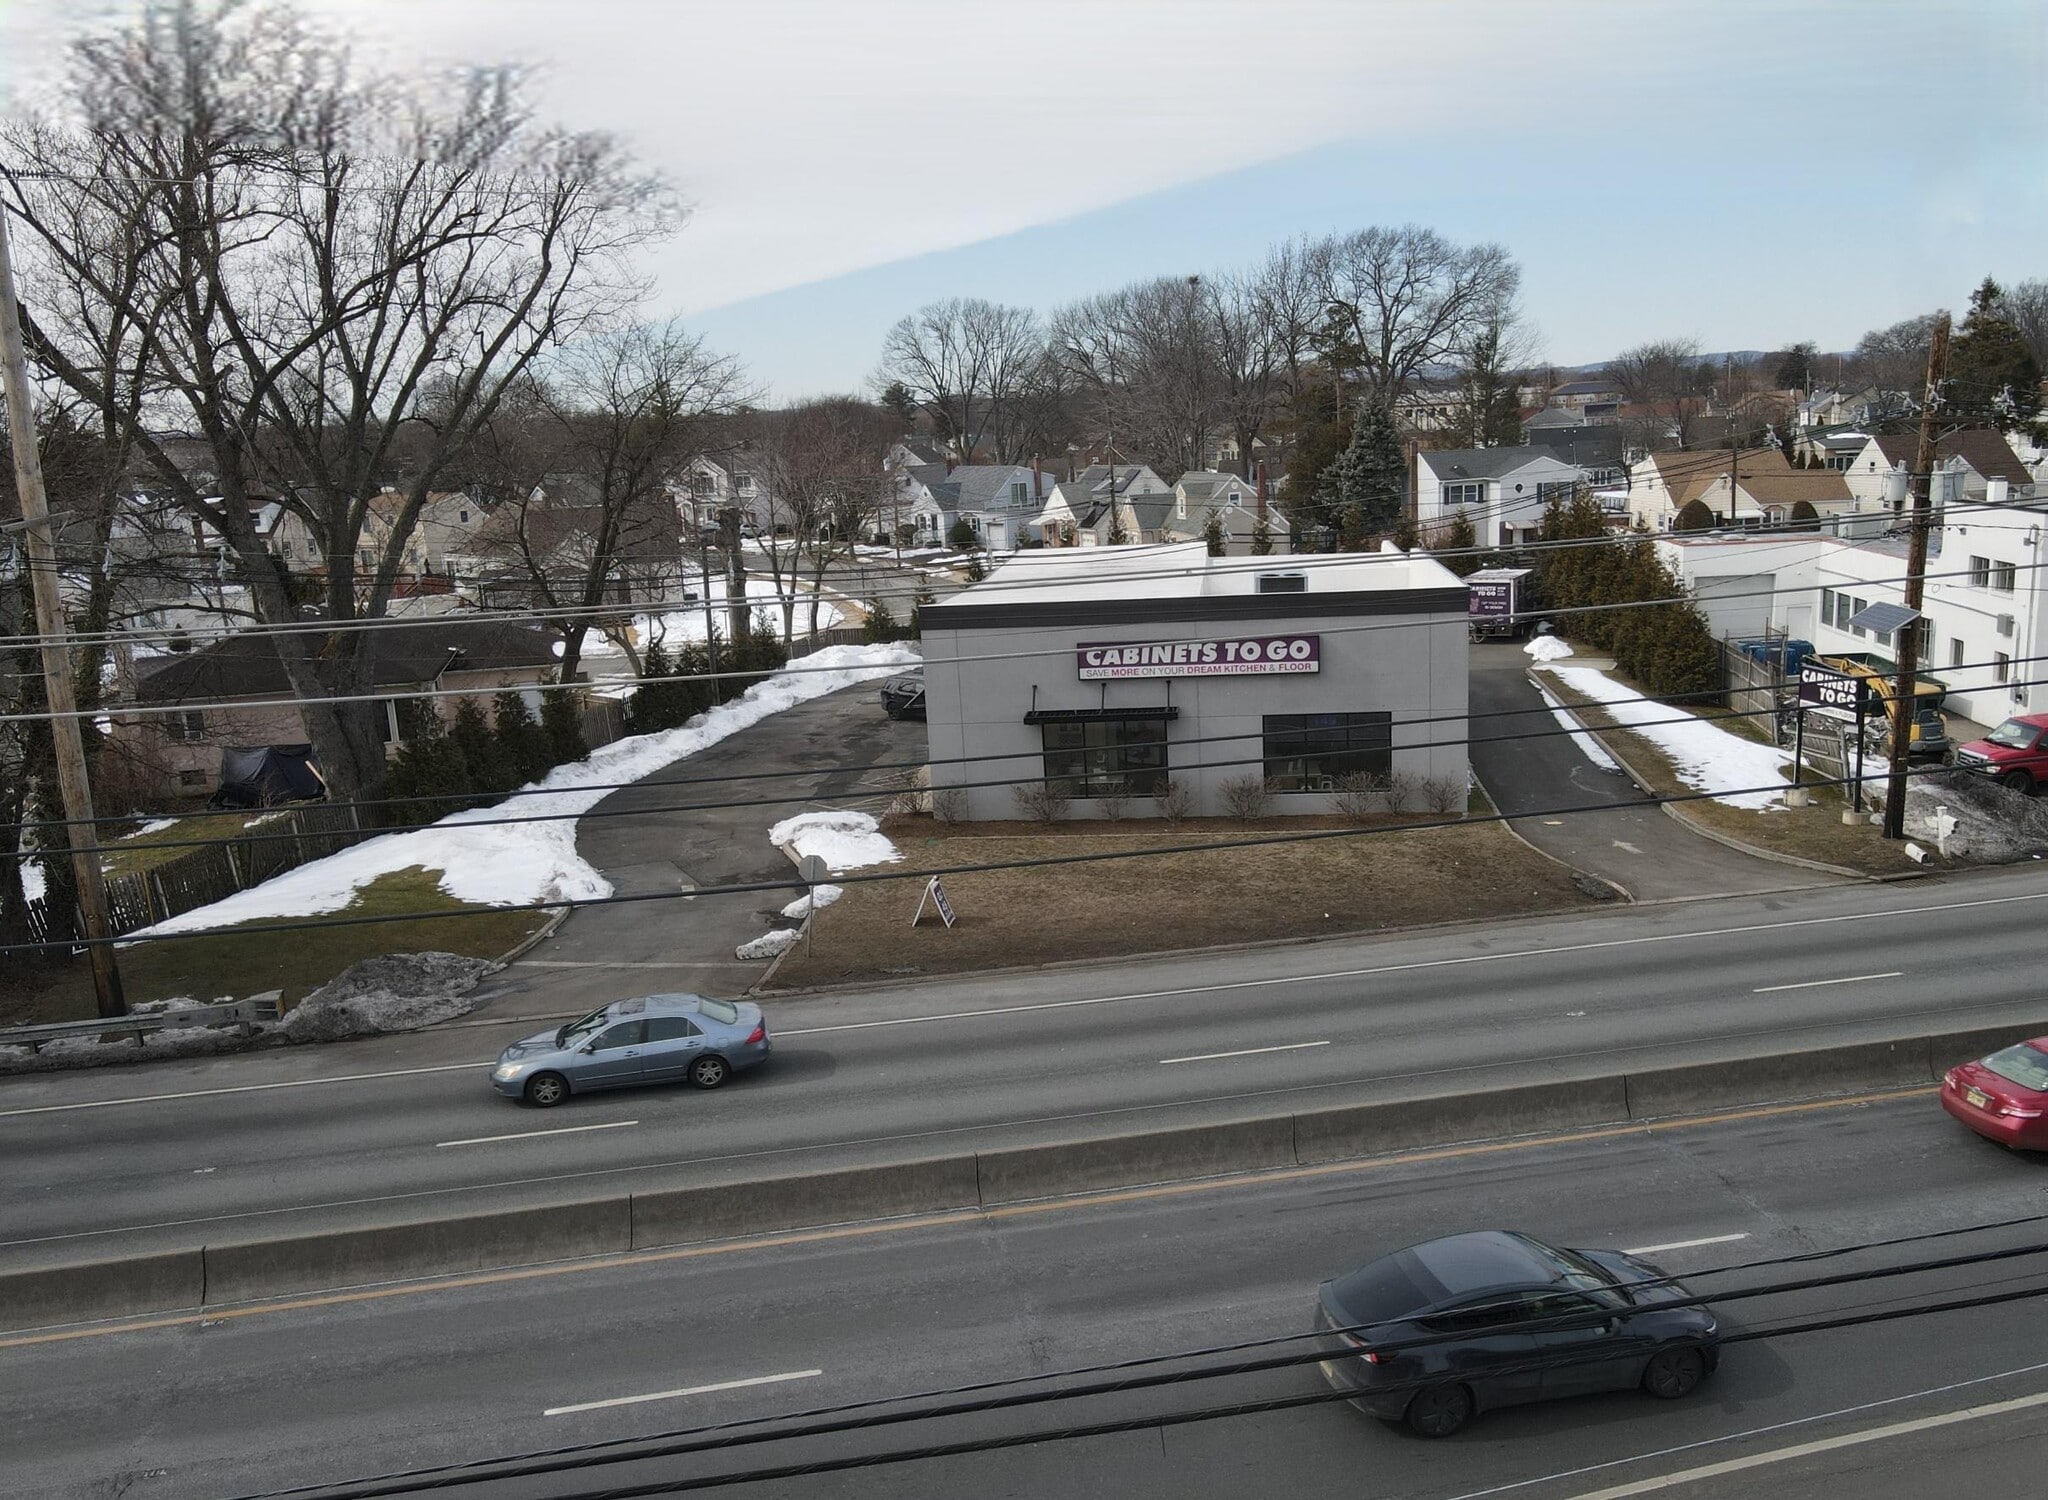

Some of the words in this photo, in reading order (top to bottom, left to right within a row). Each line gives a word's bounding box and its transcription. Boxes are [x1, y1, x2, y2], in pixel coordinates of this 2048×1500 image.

[1086, 642, 1218, 666] CABINETS
[1225, 641, 1261, 661] TO
[1266, 640, 1311, 660] GO
[1086, 669, 1110, 677] SAVE
[1111, 668, 1140, 677] MORE
[1142, 667, 1156, 676] ON
[1157, 666, 1185, 675] YOUR
[1187, 665, 1222, 674] DREAM
[1224, 663, 1267, 673] KITCHEN
[1278, 662, 1312, 671] FLOOR
[1819, 687, 1836, 703] TO
[1836, 692, 1857, 708] GO
